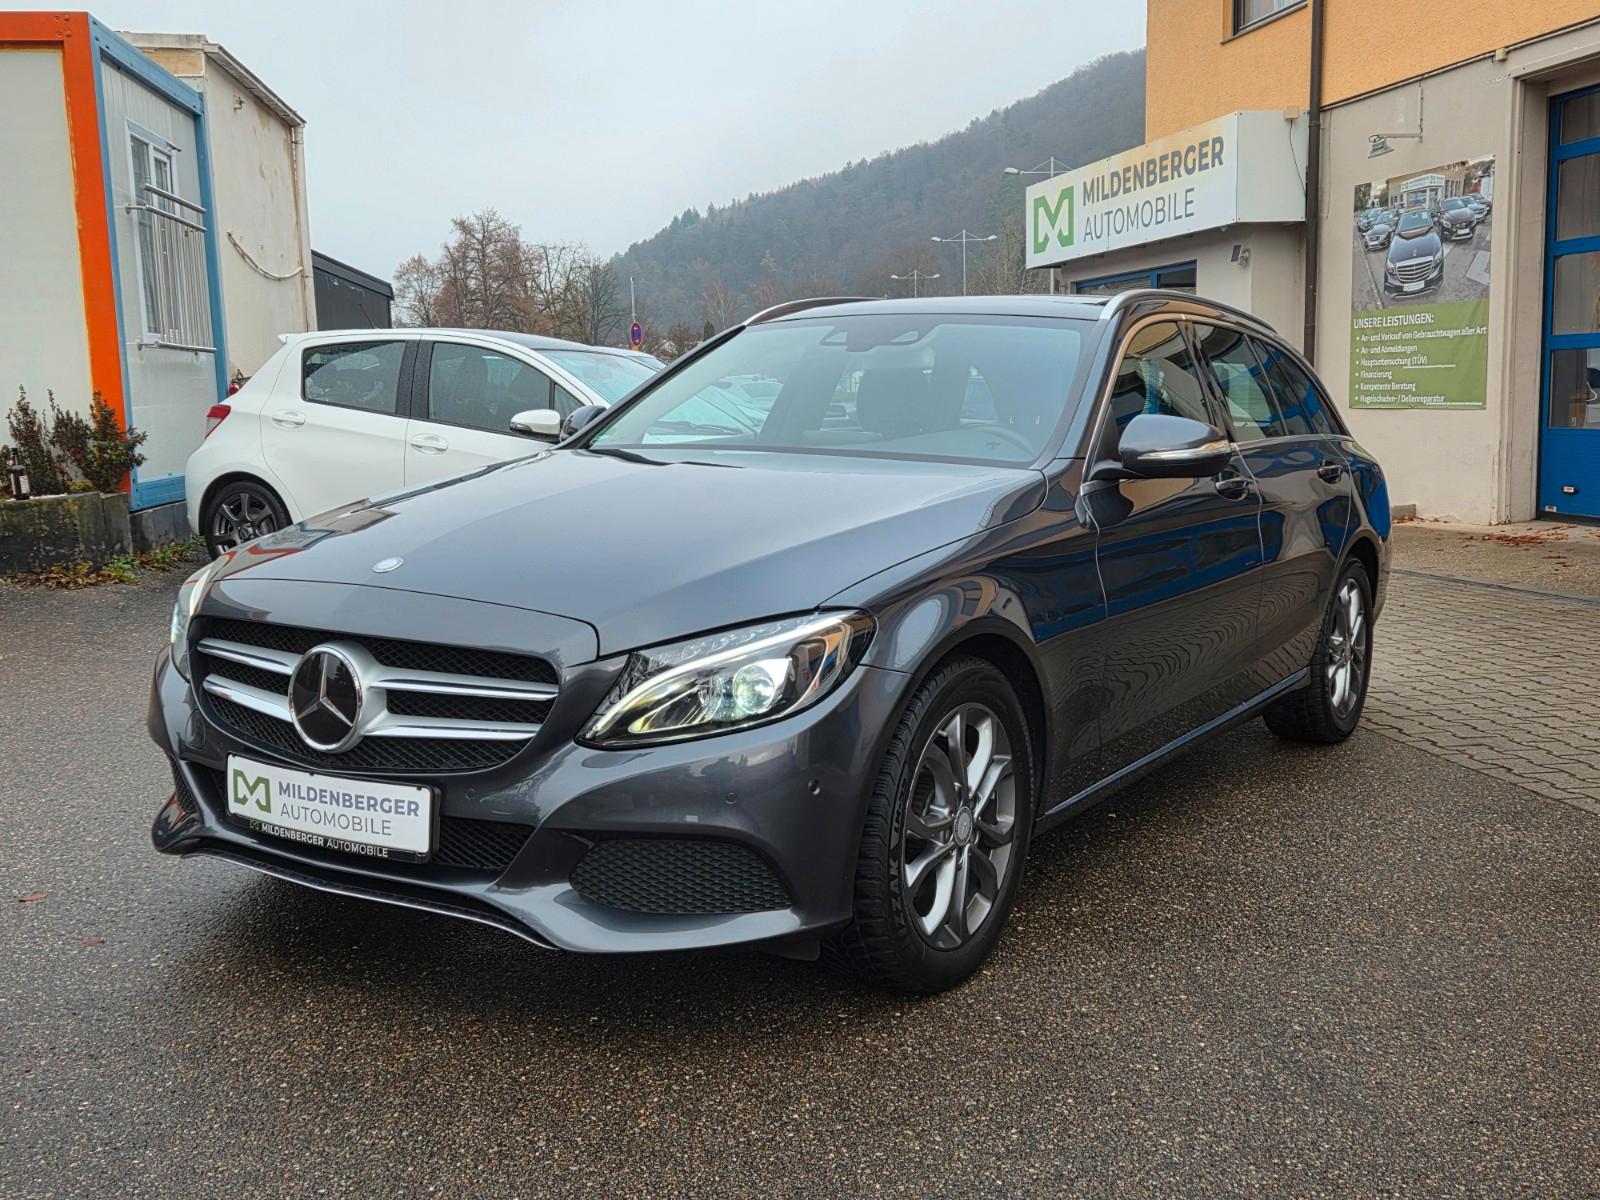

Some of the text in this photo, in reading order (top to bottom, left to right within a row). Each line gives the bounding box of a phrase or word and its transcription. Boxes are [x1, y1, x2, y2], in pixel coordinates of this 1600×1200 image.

[1082, 136, 1224, 206] MILDENBERGER
[1083, 188, 1195, 242] AUTOMOBILE
[1354, 313, 1434, 328] UNSERE LEISTUNGEN:
[1371, 333, 1381, 341] und
[1381, 331, 1402, 341] Verkauf
[1413, 328, 1460, 339] Gebrauchtwagen
[1461, 327, 1475, 335] aller
[1476, 326, 1487, 334] Art
[1412, 354, 1427, 365] (TÜV)
[1360, 382, 1416, 391] Kompetente Beratung
[1361, 370, 1392, 380] Finanzierung
[278, 781, 419, 817] MILDENBERGER
[280, 803, 392, 836] AUTOMOBILE
[261, 823, 388, 858] MILDENBERGER AUTOMOBILE
